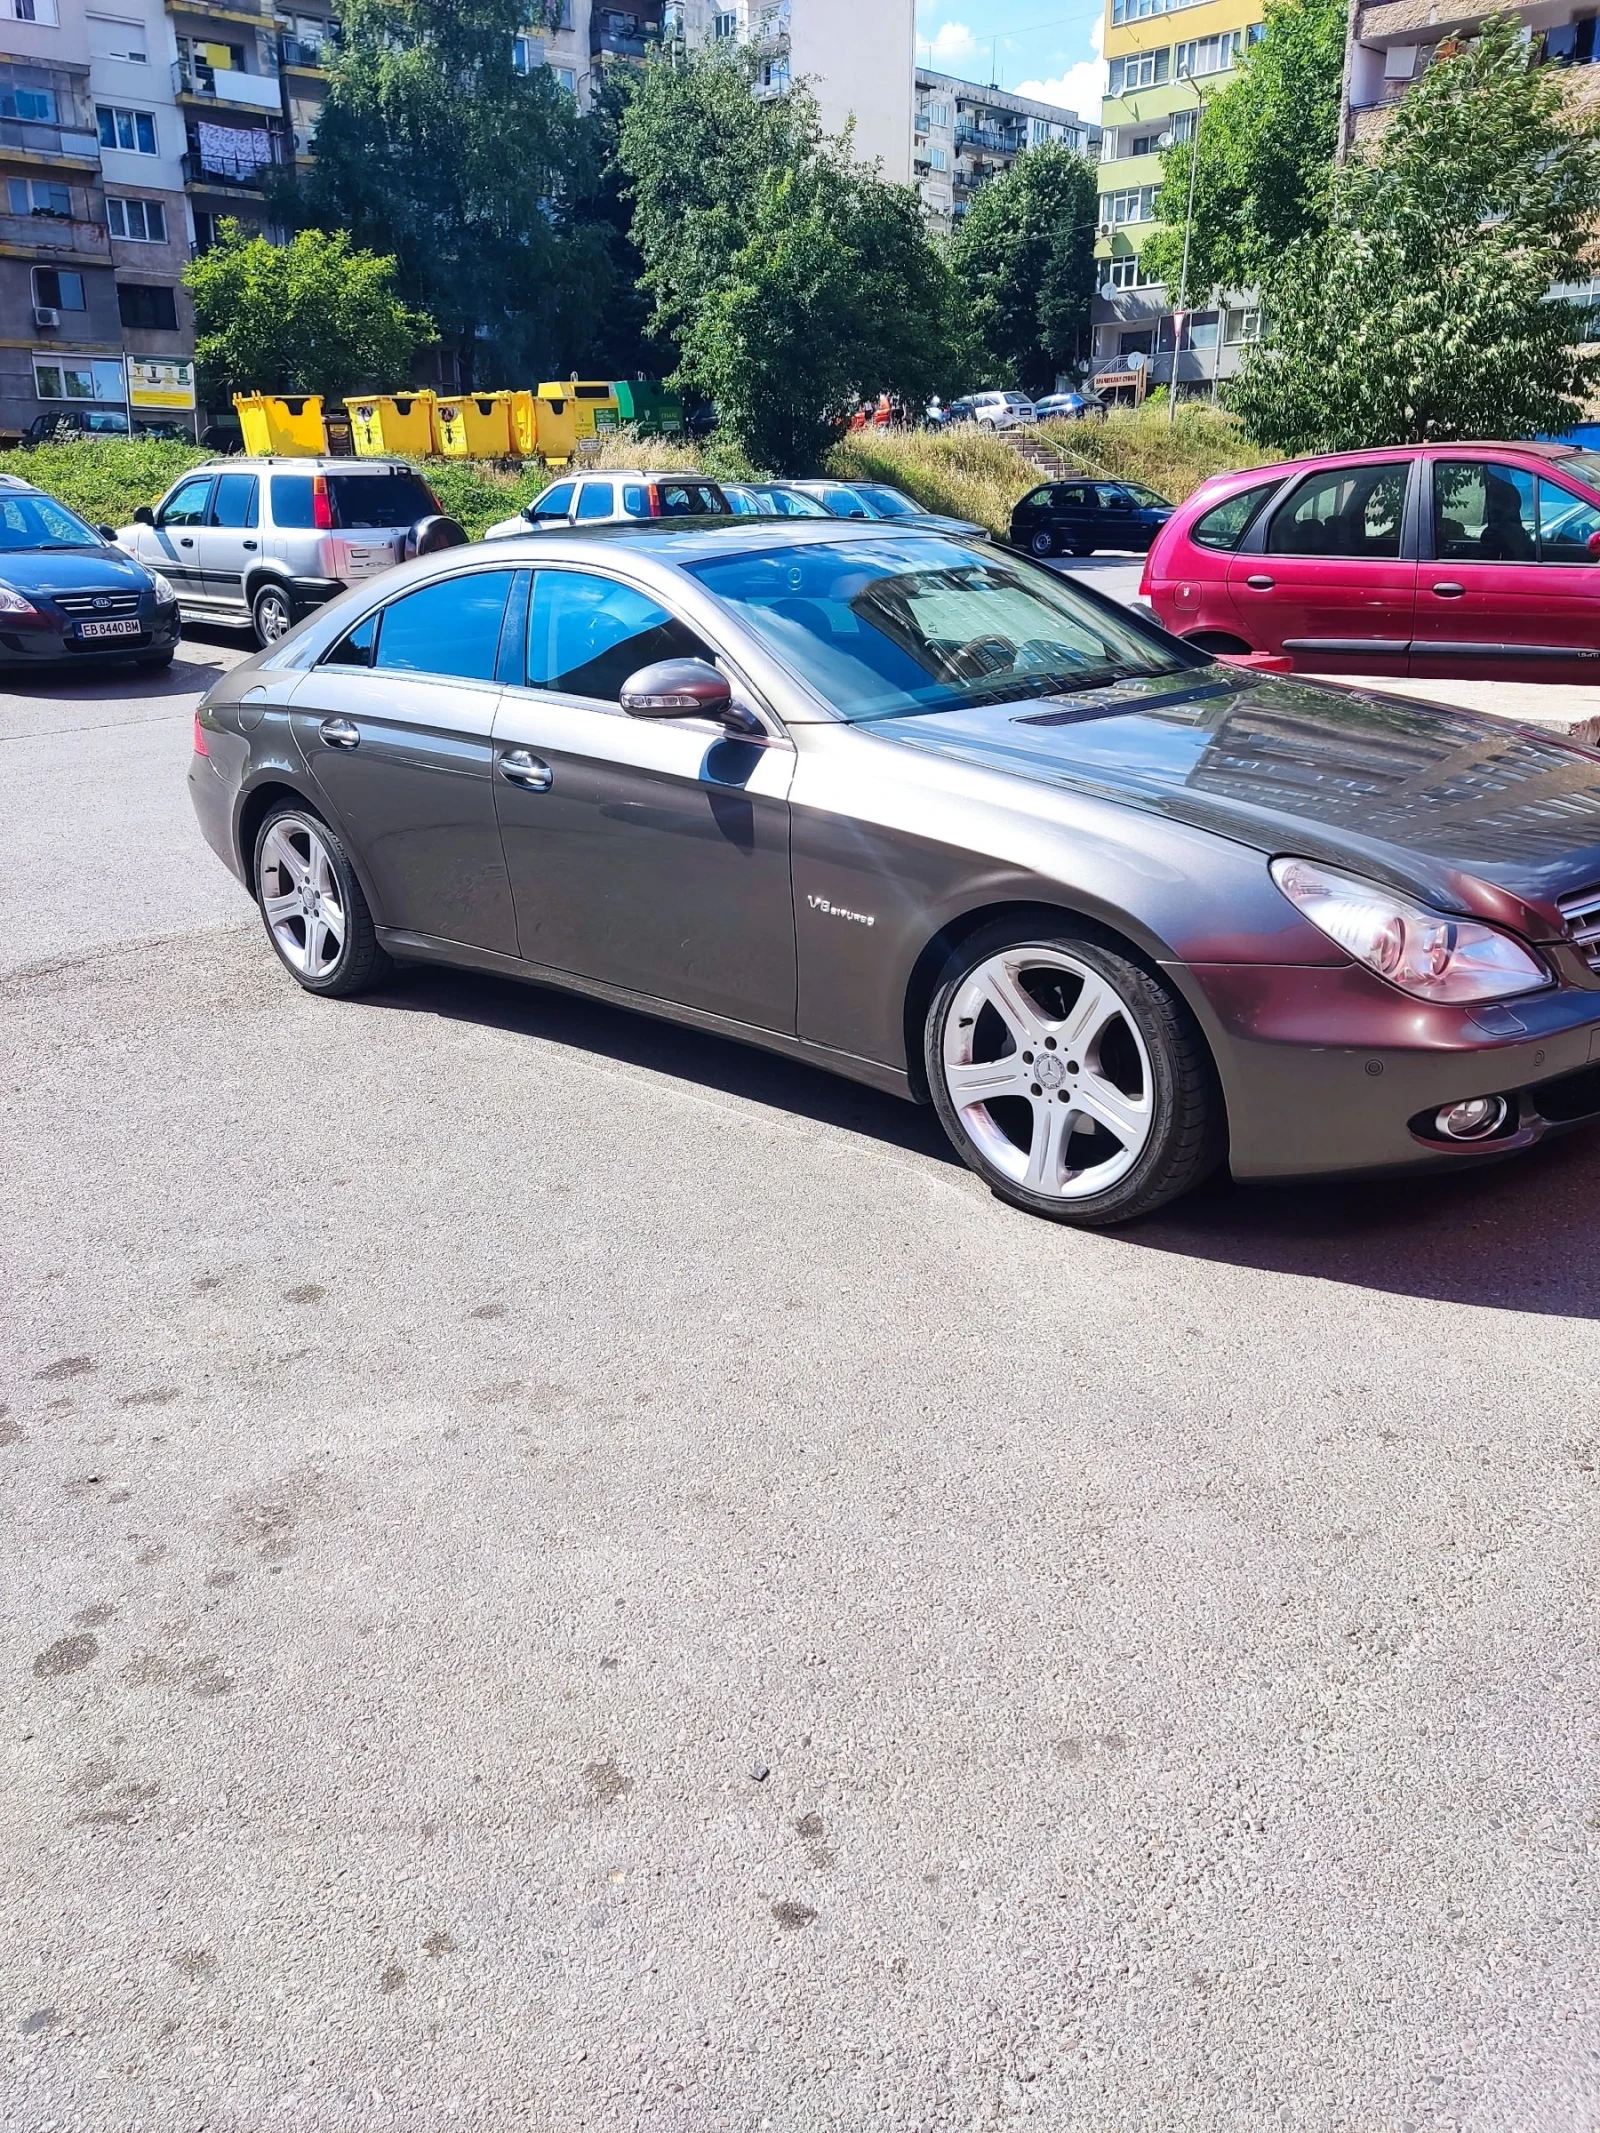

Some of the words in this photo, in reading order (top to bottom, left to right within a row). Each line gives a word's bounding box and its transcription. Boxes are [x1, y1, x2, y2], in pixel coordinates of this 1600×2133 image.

[83, 624, 98, 636] EB
[99, 622, 124, 635] 8440
[126, 621, 139, 632] BM
